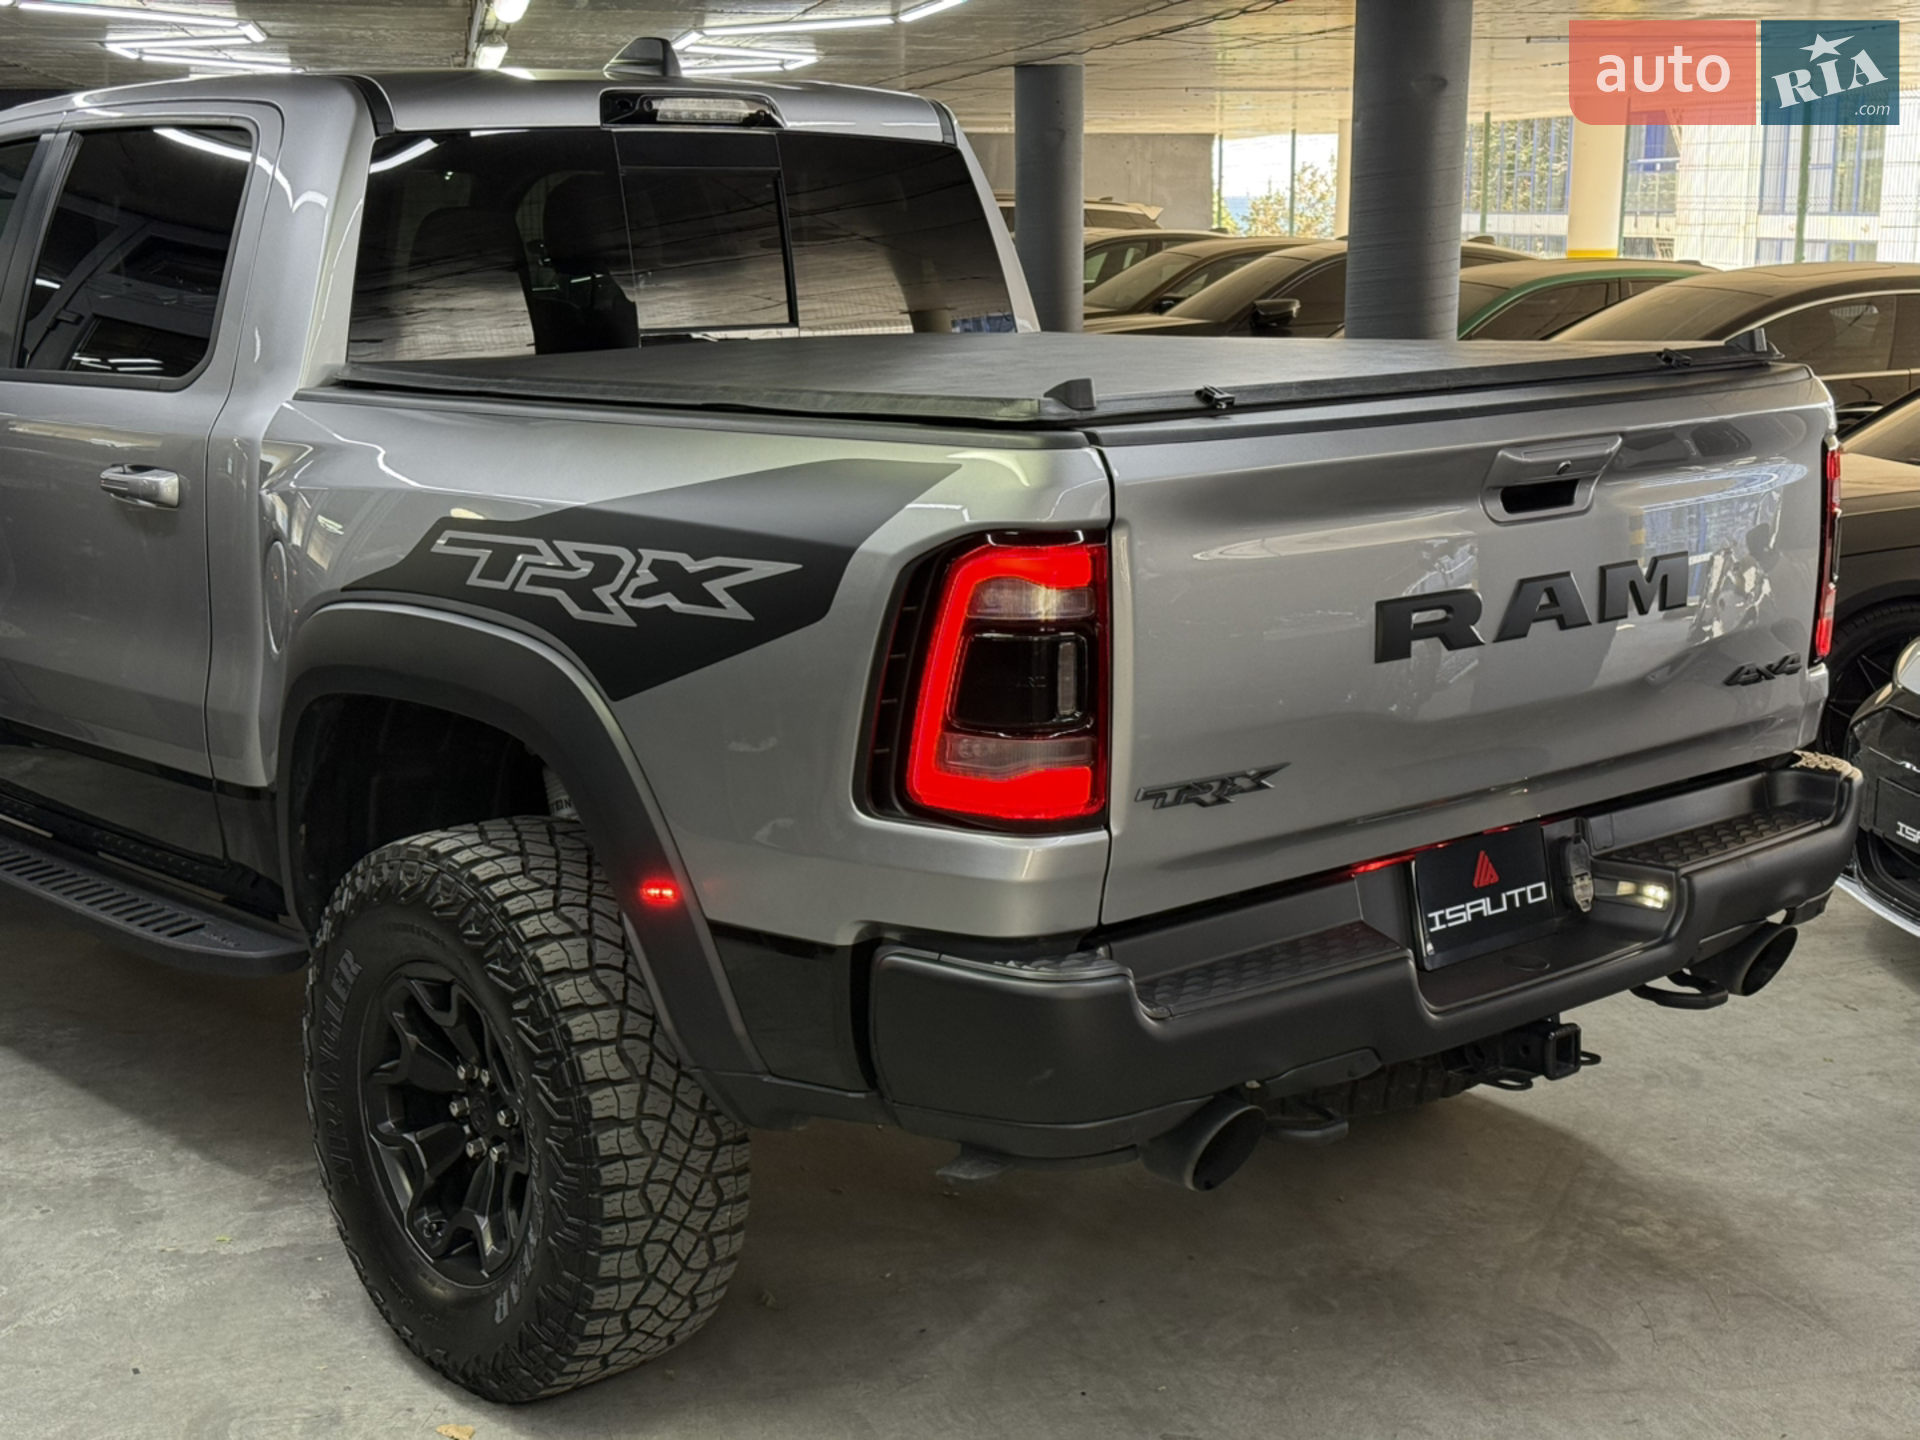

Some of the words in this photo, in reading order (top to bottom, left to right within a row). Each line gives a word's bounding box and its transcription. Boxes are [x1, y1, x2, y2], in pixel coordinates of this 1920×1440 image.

[430, 529, 804, 627] TRX
[1374, 551, 1689, 664] RAM
[1134, 762, 1292, 810] TRX
[1427, 881, 1548, 932] ISAUTO
